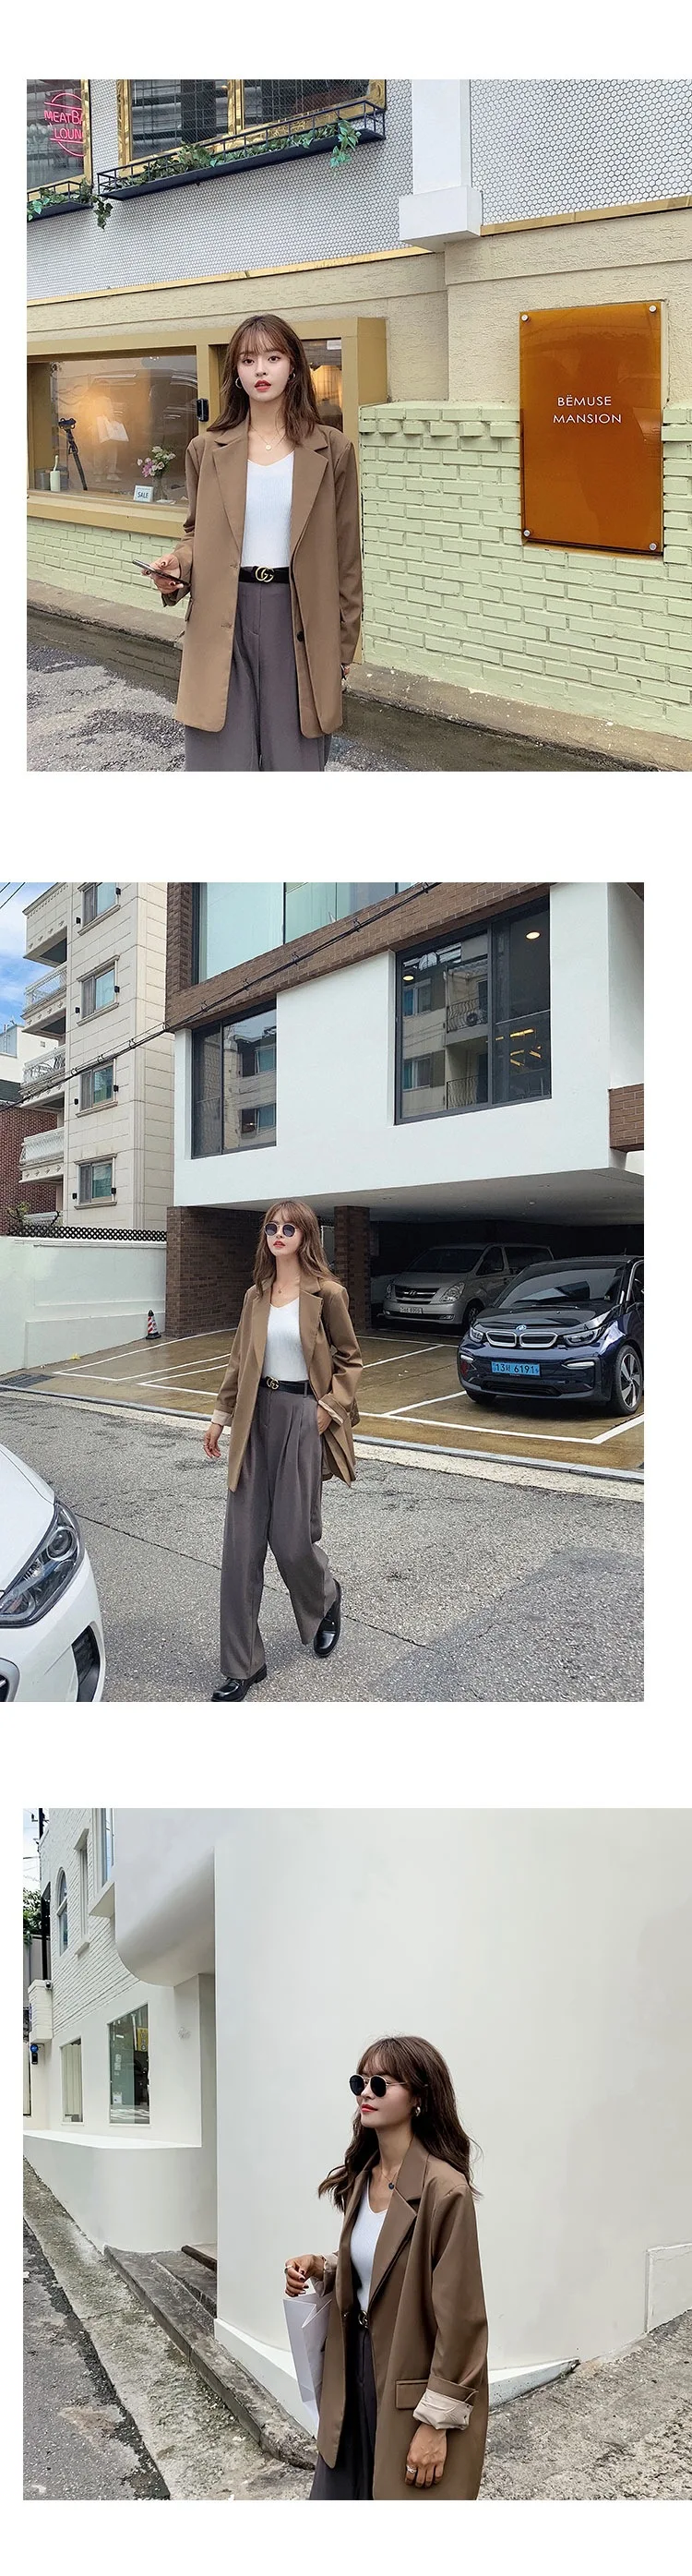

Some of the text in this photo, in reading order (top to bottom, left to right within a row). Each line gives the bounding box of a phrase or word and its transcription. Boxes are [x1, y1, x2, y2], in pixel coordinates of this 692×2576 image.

[54, 127, 83, 139] LOUN
[557, 394, 612, 406] BËMUSE
[554, 413, 621, 424] MANSION
[514, 1365, 534, 1373] 6191
